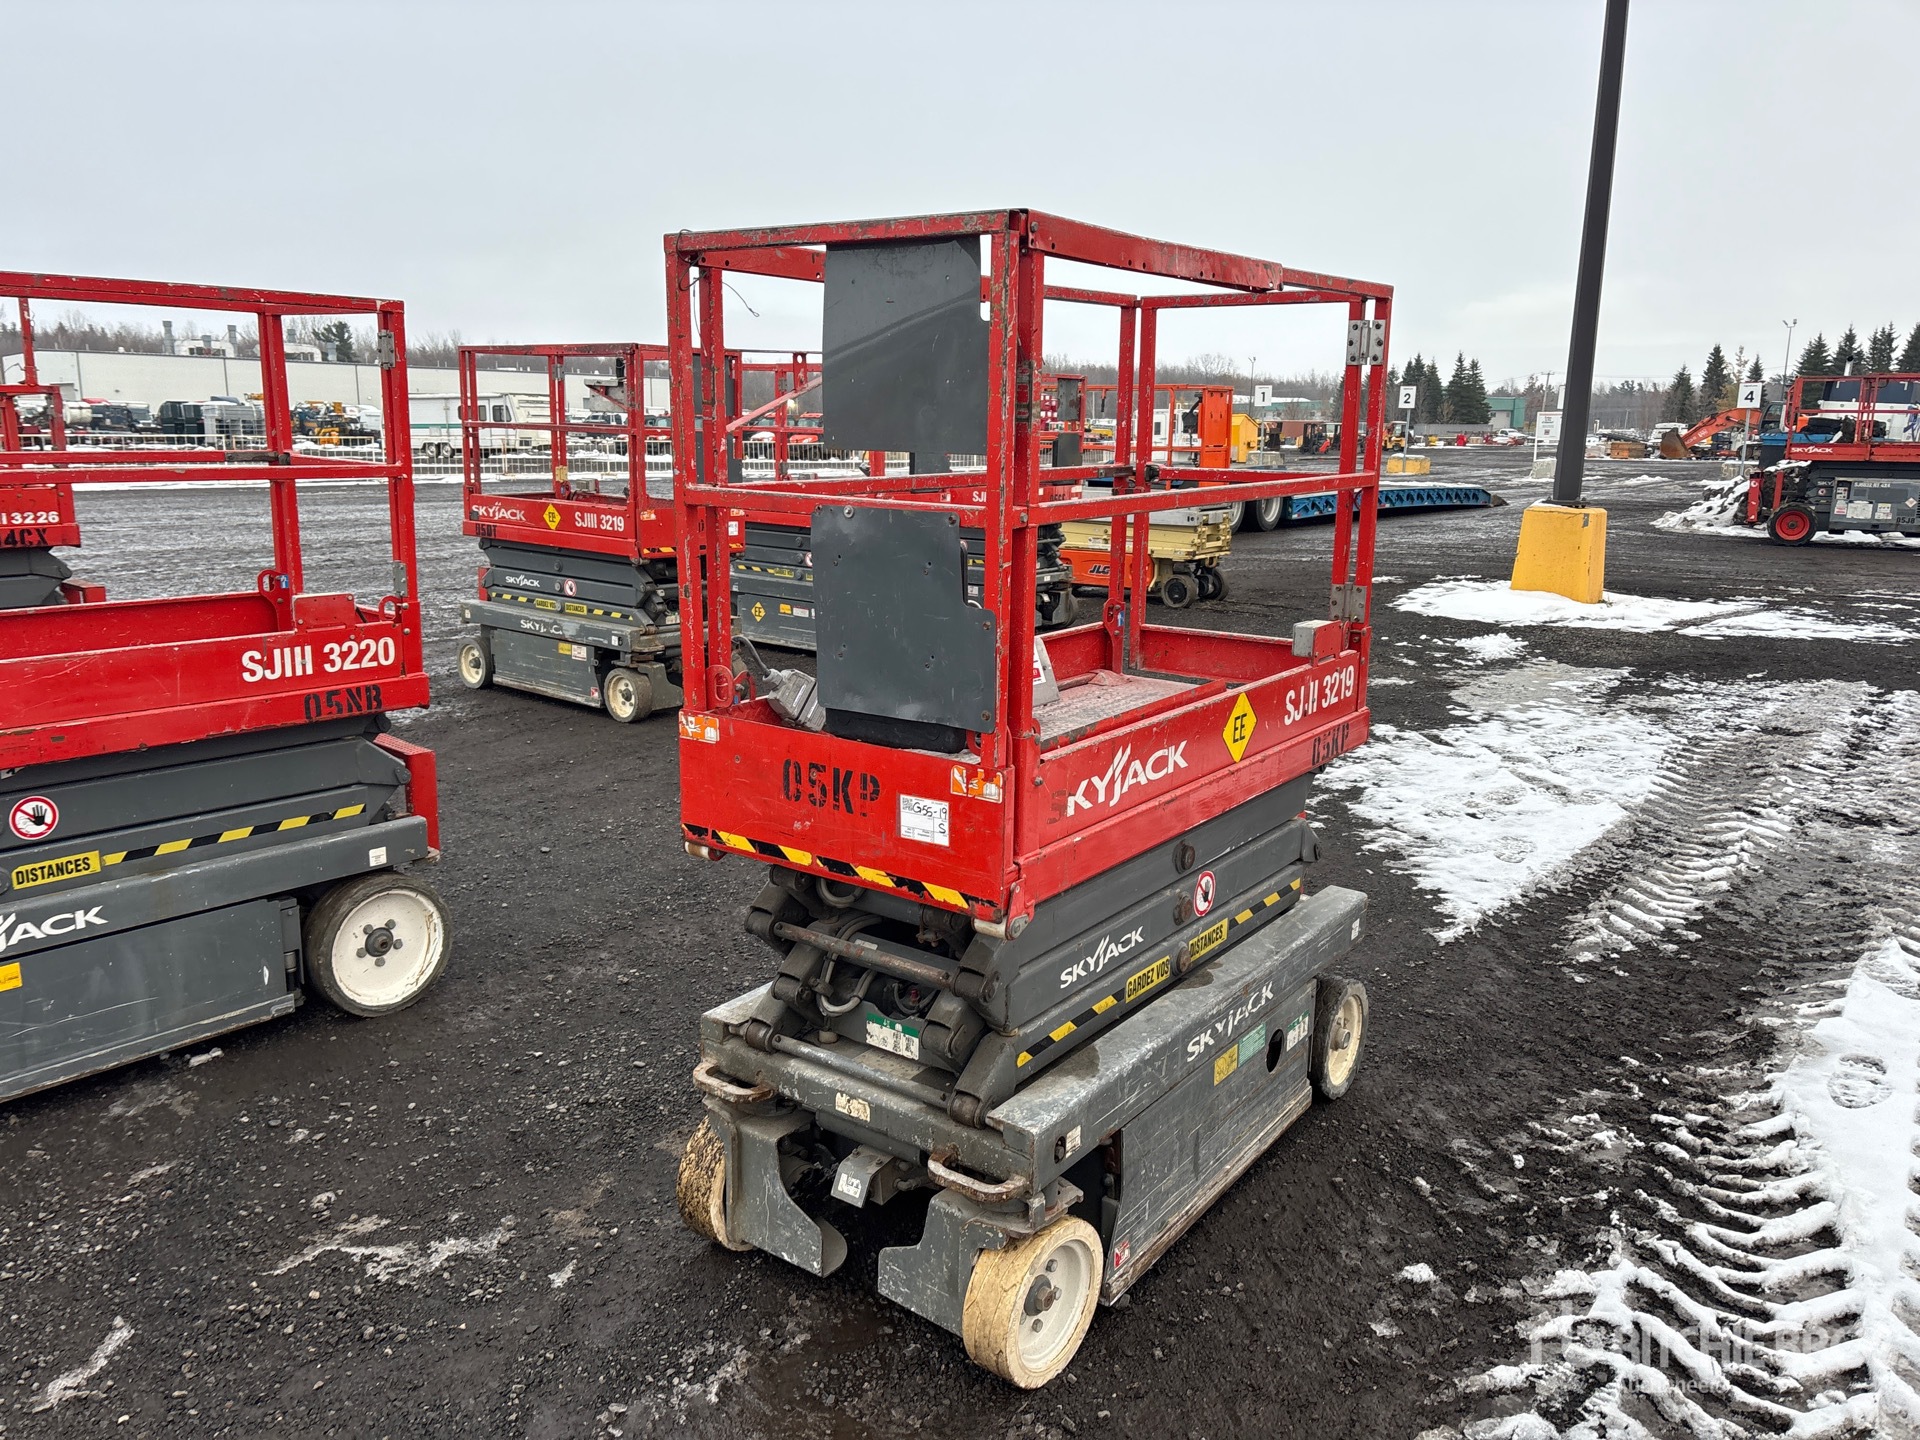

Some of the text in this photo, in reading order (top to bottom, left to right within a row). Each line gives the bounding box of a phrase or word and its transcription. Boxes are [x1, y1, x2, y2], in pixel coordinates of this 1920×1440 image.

[1260, 391, 1266, 402] 1
[1404, 393, 1411, 404] 2
[1744, 391, 1754, 402] 4
[1790, 446, 1833, 454] SKYJACK
[10, 511, 60, 524] 3226
[472, 502, 526, 521] SKYJACK
[574, 512, 624, 532] SJIII 3219
[0, 528, 48, 546] 4CX
[506, 575, 540, 588] SKYJACK
[242, 638, 395, 682] SJIII 3220
[304, 684, 382, 720] 05NB
[1284, 665, 1354, 726] SJII 3219
[1233, 714, 1247, 743] EE
[16, 857, 90, 885] DISTANCES
[1190, 924, 1224, 957] DISTANCES
[1060, 926, 1144, 988] SKYJACK
[1127, 958, 1170, 998] GARDEZ VOS
[1187, 981, 1274, 1062] SKYJACK
